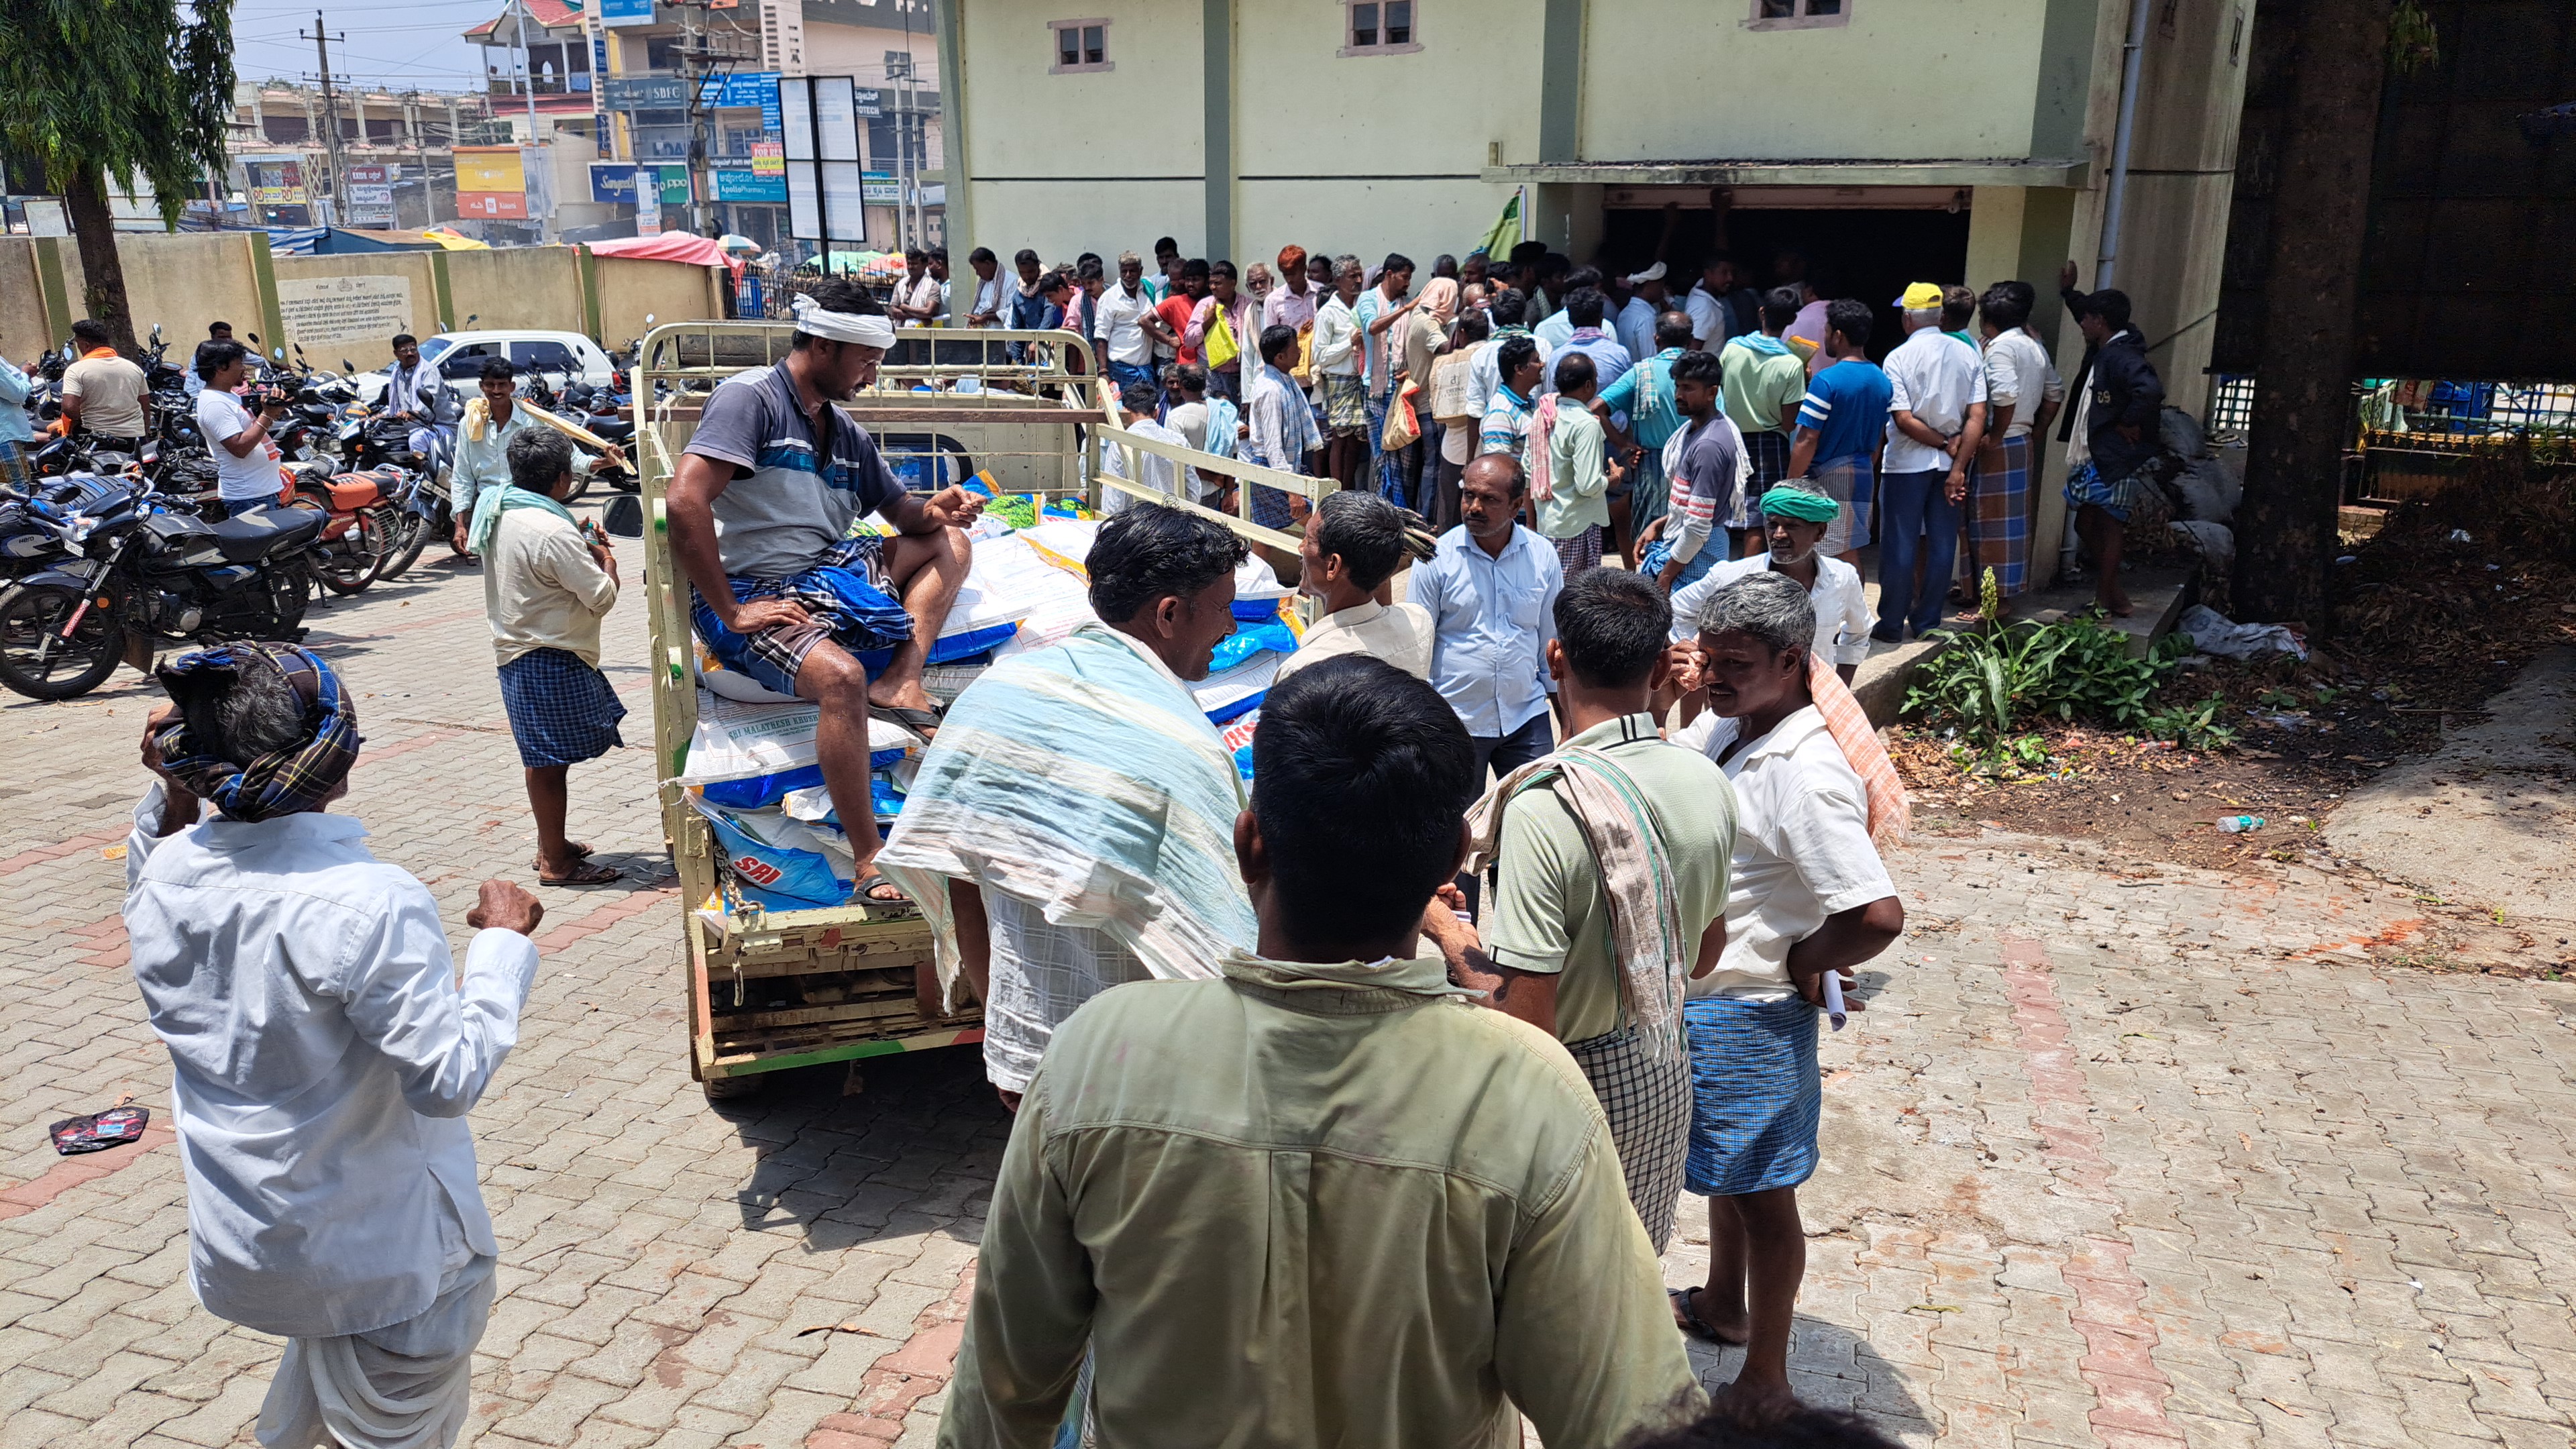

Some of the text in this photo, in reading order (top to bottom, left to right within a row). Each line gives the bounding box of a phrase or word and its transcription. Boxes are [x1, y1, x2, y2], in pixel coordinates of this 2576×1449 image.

[769, 147, 783, 156] REN
[19, 536, 34, 544] Hero
[729, 729, 743, 741] SRI
[744, 718, 791, 735] MALATHESH
[793, 714, 818, 724] KRUSH
[733, 855, 783, 885] SRI
